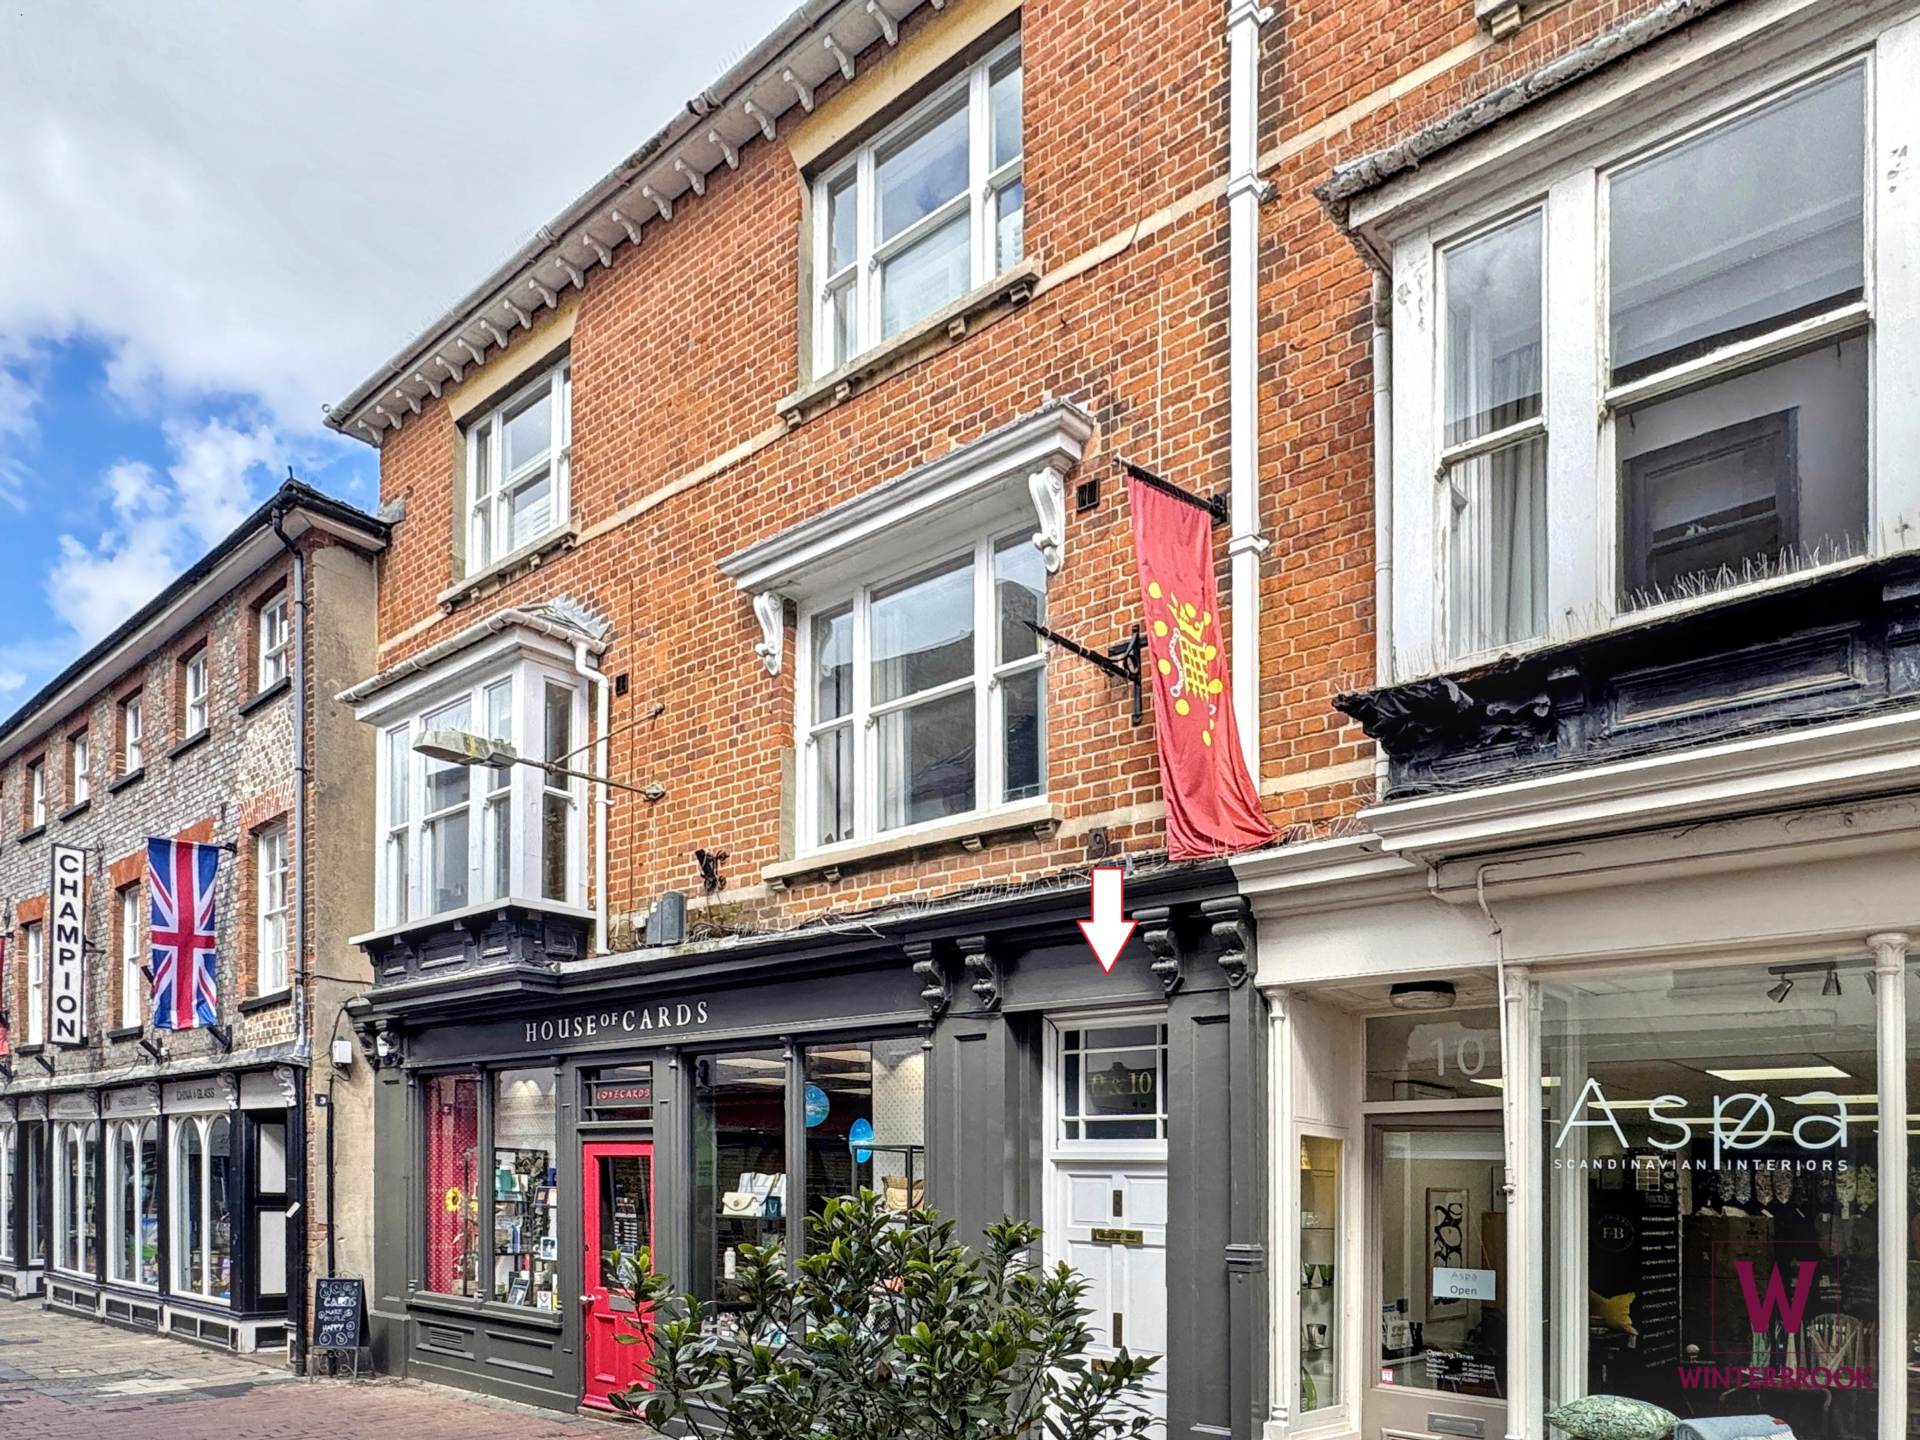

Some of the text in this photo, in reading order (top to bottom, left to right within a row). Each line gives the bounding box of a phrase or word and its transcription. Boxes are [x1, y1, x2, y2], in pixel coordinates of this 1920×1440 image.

[57, 855, 79, 1037] CHAMPION
[525, 1001, 708, 1042] HOUSE OF CARDS
[1431, 1037, 1485, 1076] 10
[1128, 1072, 1152, 1094] 10
[1554, 1159, 1848, 1171] SCANDINAVIAN INTERIORS
[1450, 1285, 1477, 1296] Open
[323, 1296, 357, 1307] CARDS
[322, 1323, 345, 1332] HAPPY
